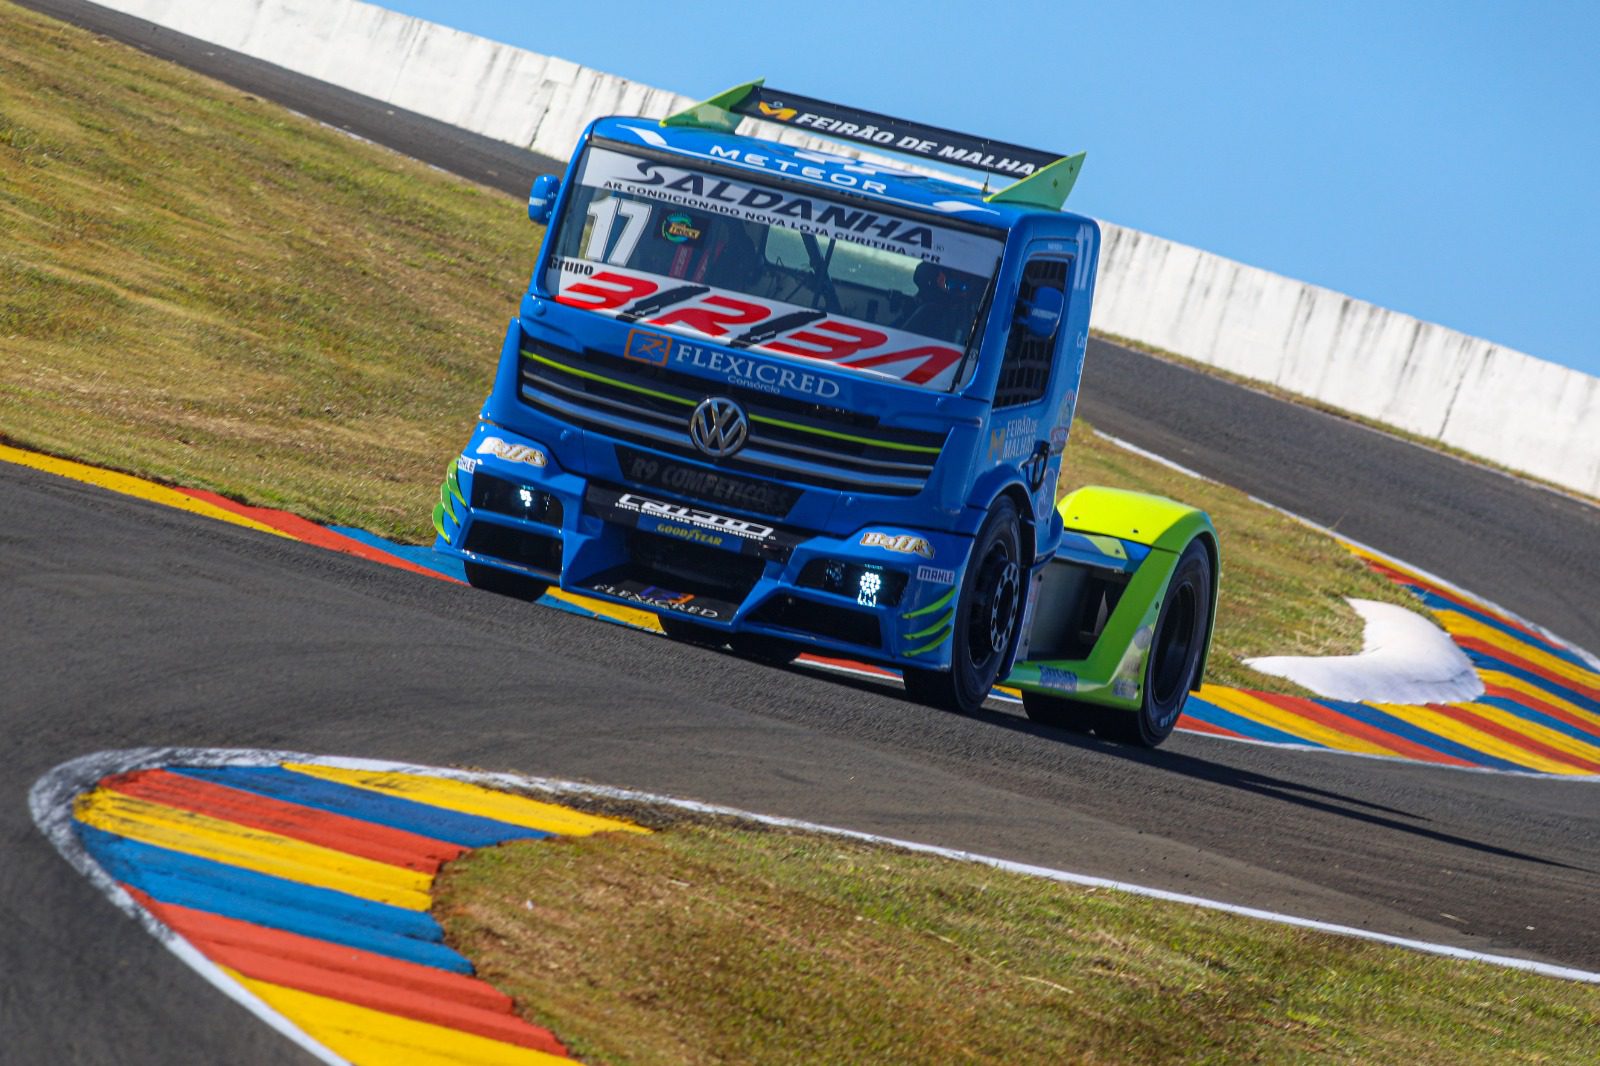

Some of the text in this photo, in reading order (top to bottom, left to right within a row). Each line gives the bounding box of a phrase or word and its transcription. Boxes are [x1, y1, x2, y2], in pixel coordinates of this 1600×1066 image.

[796, 113, 895, 145] FEIRÃO
[896, 135, 938, 154] DE
[710, 145, 887, 194] METEOR
[603, 180, 622, 192] AR
[627, 185, 740, 216] CONDICIONADO
[745, 212, 787, 229] NOVA
[789, 218, 830, 239] LOJA
[834, 228, 906, 256] CURITIBA
[921, 252, 941, 264] PR
[612, 161, 934, 249] SALDANHA
[585, 196, 653, 267] 17
[551, 258, 594, 277] Grupo
[675, 343, 841, 399] FLEXICRED
[1006, 415, 1032, 438] FEIRÃO
[631, 457, 658, 480] R9
[657, 523, 724, 546] GOODYEAR
[919, 567, 954, 584] MAHLE
